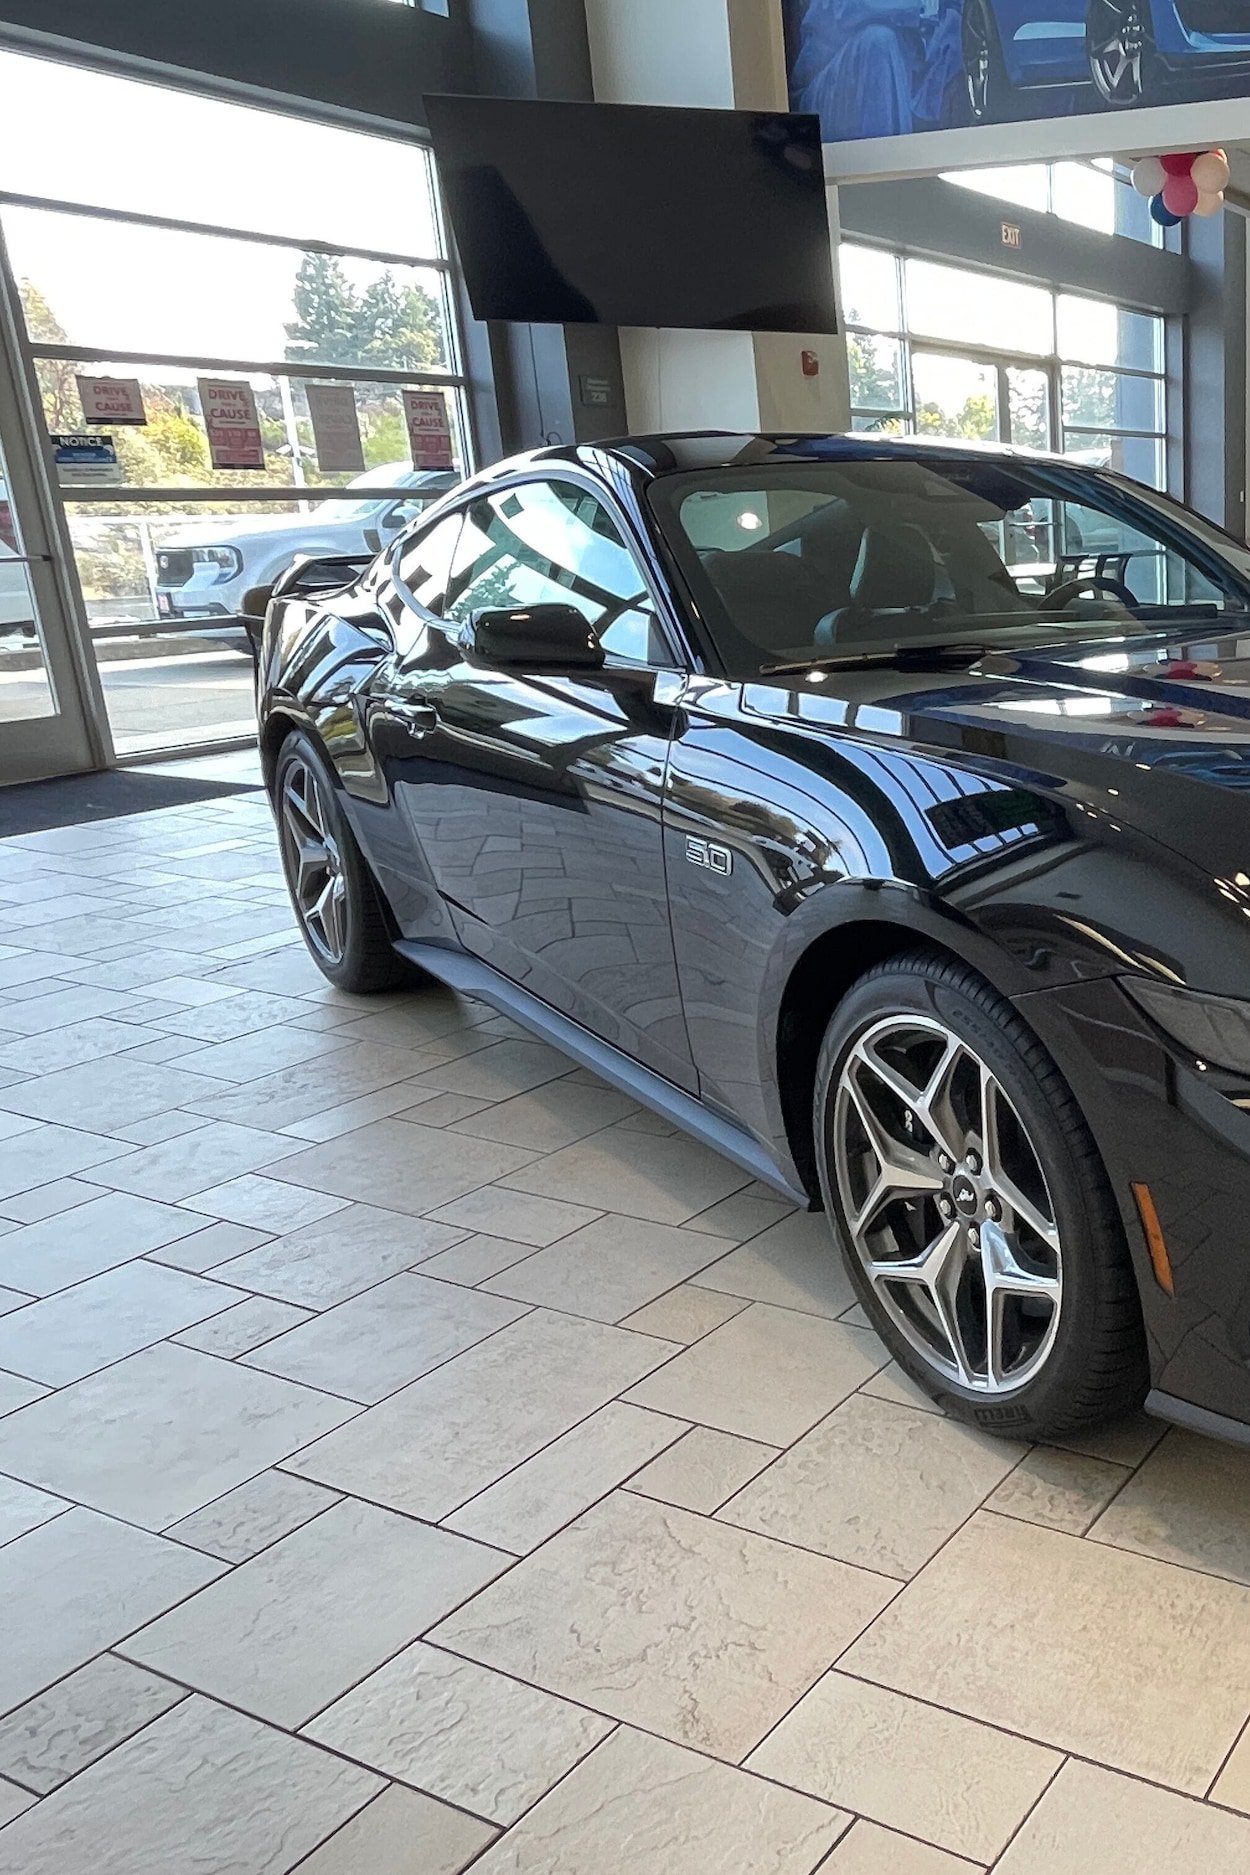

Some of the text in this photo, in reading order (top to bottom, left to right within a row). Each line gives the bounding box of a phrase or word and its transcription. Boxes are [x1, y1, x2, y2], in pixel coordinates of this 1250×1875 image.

[1002, 224, 1020, 246] EXIT
[94, 386, 129, 397] DRIVE
[208, 389, 247, 402] DRIVE
[95, 402, 133, 412] CAUSE
[411, 401, 440, 411] DRIVE
[210, 408, 252, 420] CAUSE
[413, 416, 444, 428] CAUSE
[60, 437, 103, 447] NOTICE
